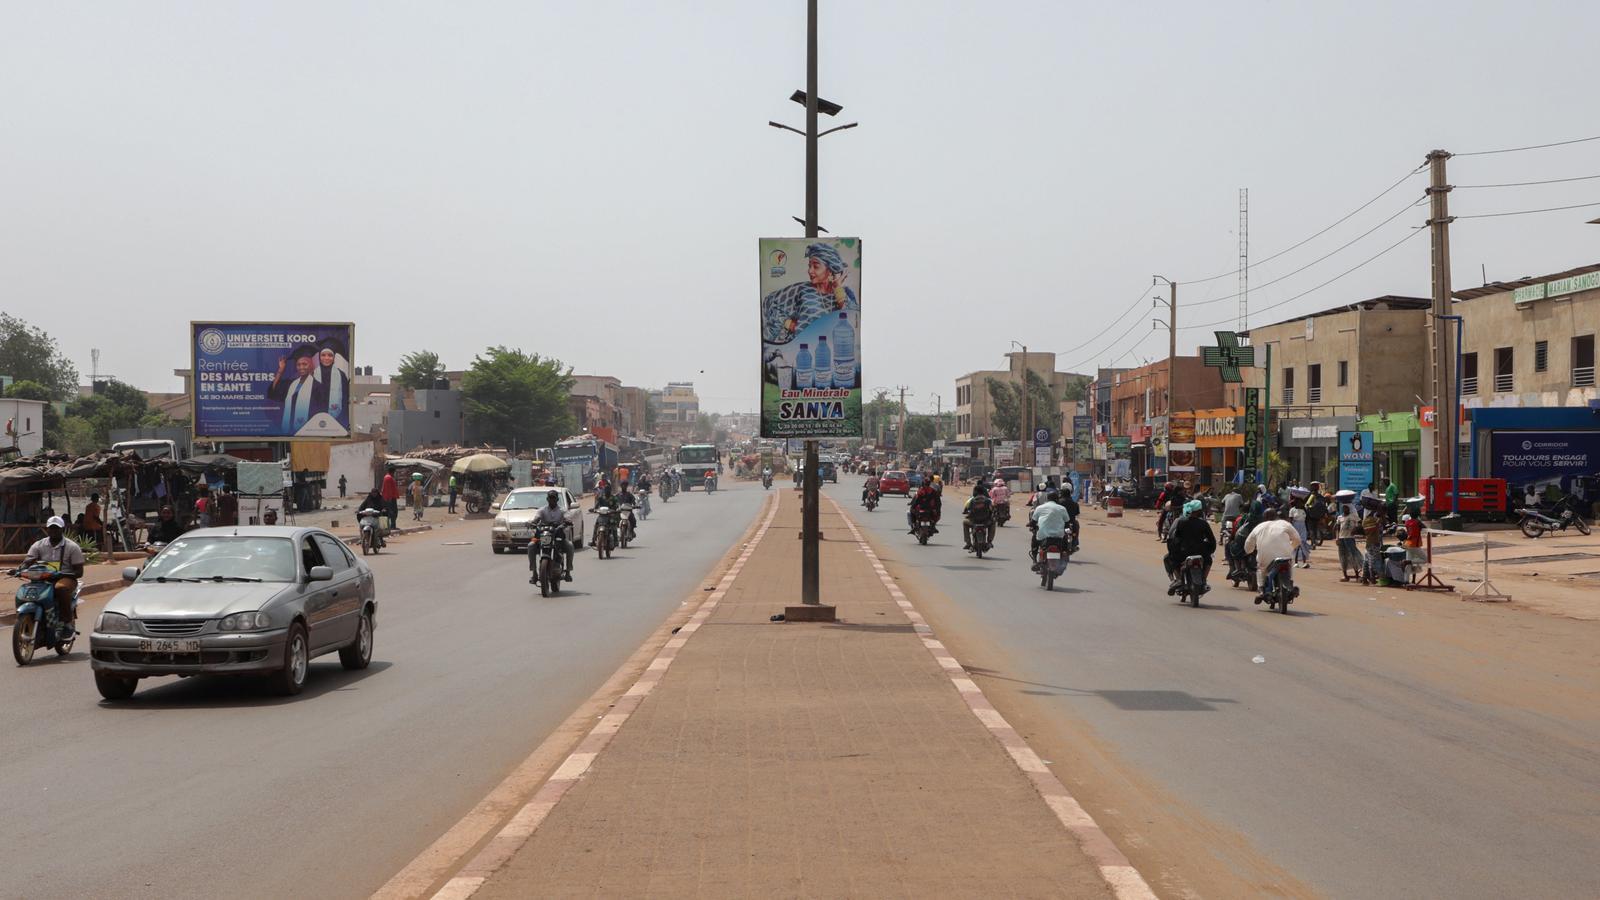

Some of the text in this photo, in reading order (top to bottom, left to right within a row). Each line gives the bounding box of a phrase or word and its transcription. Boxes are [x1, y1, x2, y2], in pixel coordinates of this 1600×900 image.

[1574, 272, 1600, 290] SANOGO
[226, 334, 316, 343] UNIVERSITE KORO
[198, 358, 248, 371] Rentrée
[200, 372, 275, 381] DES MASTERS
[200, 382, 251, 392] EN SANTE
[781, 387, 849, 398] Eau Minérale
[780, 401, 843, 419] SANYA
[1246, 388, 1257, 466] PHARMACIE
[140, 640, 199, 651] BH 2645 MD
